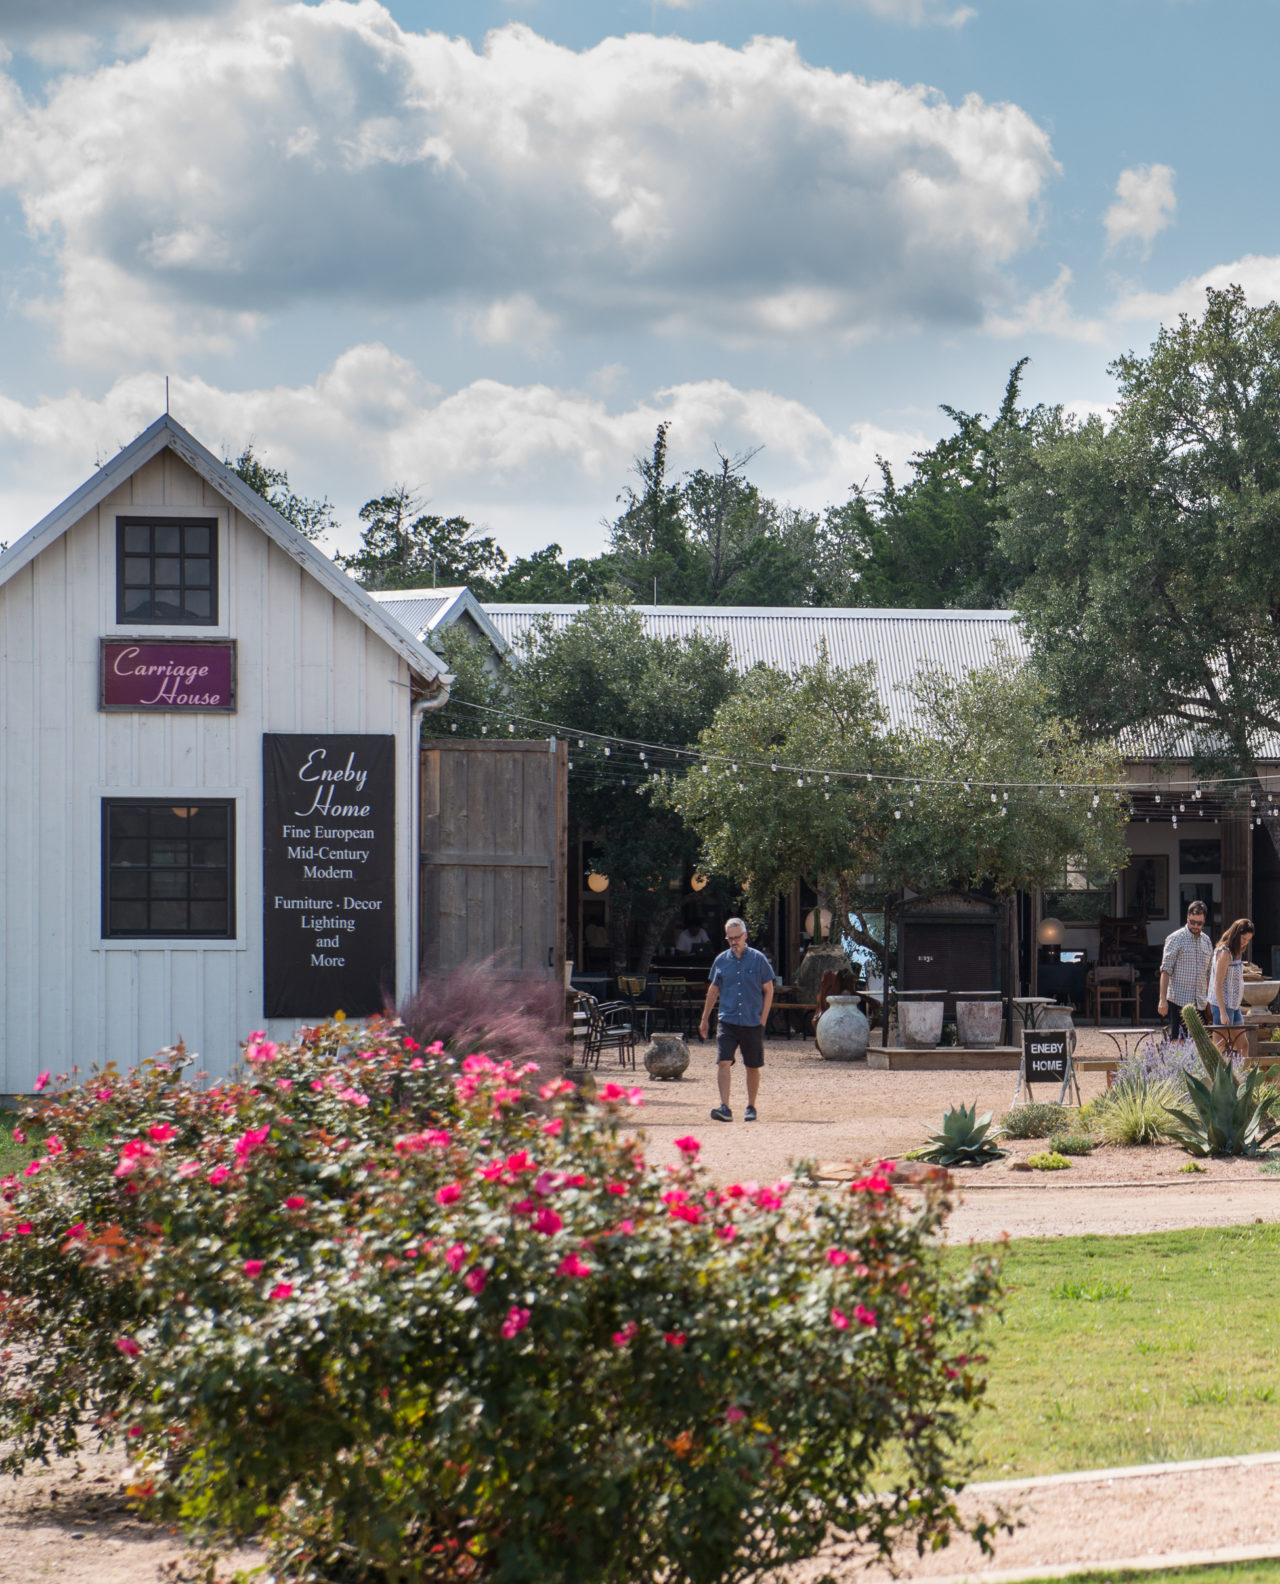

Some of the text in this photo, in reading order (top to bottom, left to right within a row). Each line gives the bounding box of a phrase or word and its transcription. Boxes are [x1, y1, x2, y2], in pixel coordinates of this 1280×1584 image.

[113, 646, 209, 685] Carriage
[140, 676, 221, 705] House
[299, 748, 368, 792] Eneby
[294, 784, 370, 817] Home
[282, 825, 375, 842] Fine European
[287, 846, 370, 863] Mid-Century
[303, 865, 353, 879] Modern
[274, 896, 383, 910] Furniture Decor
[301, 915, 356, 932] Lighting
[316, 935, 339, 948] and
[311, 953, 345, 967] More
[1031, 1043, 1064, 1054] ENEBY
[1032, 1060, 1063, 1071] HOME
